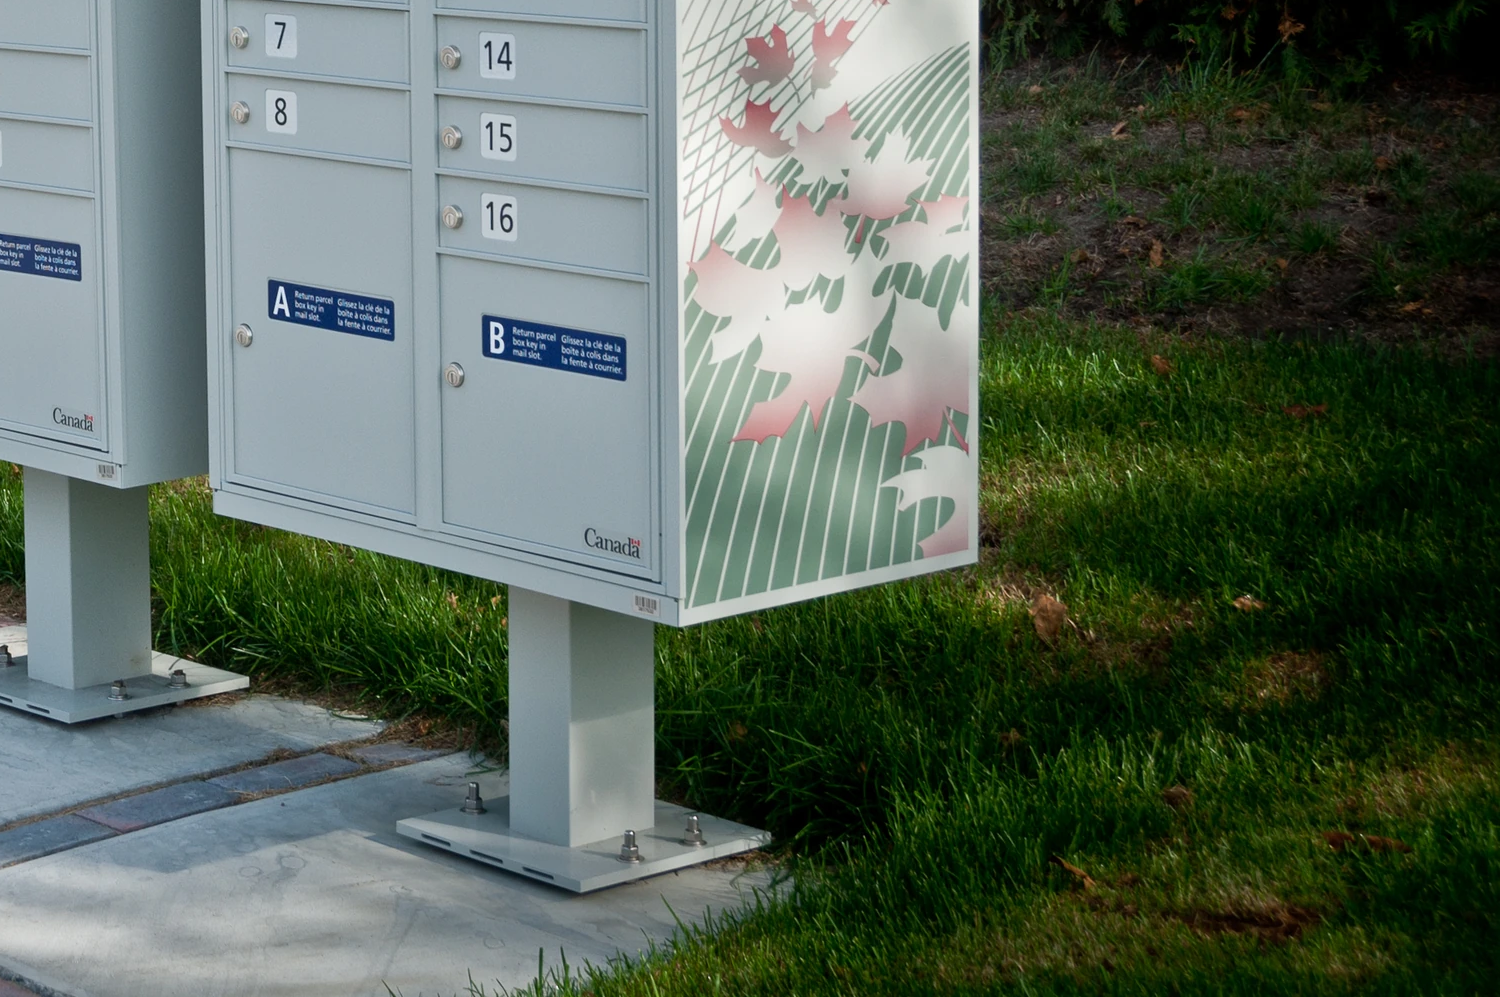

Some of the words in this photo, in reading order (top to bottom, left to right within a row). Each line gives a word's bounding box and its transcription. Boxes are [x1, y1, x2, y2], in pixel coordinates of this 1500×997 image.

[274, 21, 287, 50] 7
[483, 40, 513, 72] 14
[274, 97, 288, 126] 8
[485, 121, 513, 153] 15
[485, 201, 514, 234] 16
[273, 286, 290, 317] A
[295, 291, 314, 301] Return
[316, 296, 333, 304] parcel
[338, 299, 357, 309] Glissez
[295, 301, 306, 309] box
[307, 303, 317, 312] key
[295, 310, 307, 319] mail
[360, 312, 372, 321] colis
[374, 315, 388, 324] dans
[344, 319, 360, 329] fente
[490, 321, 505, 354] B
[513, 327, 534, 338] Return
[536, 332, 556, 341] parcel
[561, 335, 583, 346] Glissez
[513, 337, 525, 346] box
[527, 339, 538, 350] key
[513, 348, 527, 357] mail
[587, 350, 601, 360] colis
[602, 353, 619, 363] dans
[570, 357, 587, 368] fente
[53, 407, 94, 432] Canada
[584, 528, 641, 559] Canada
